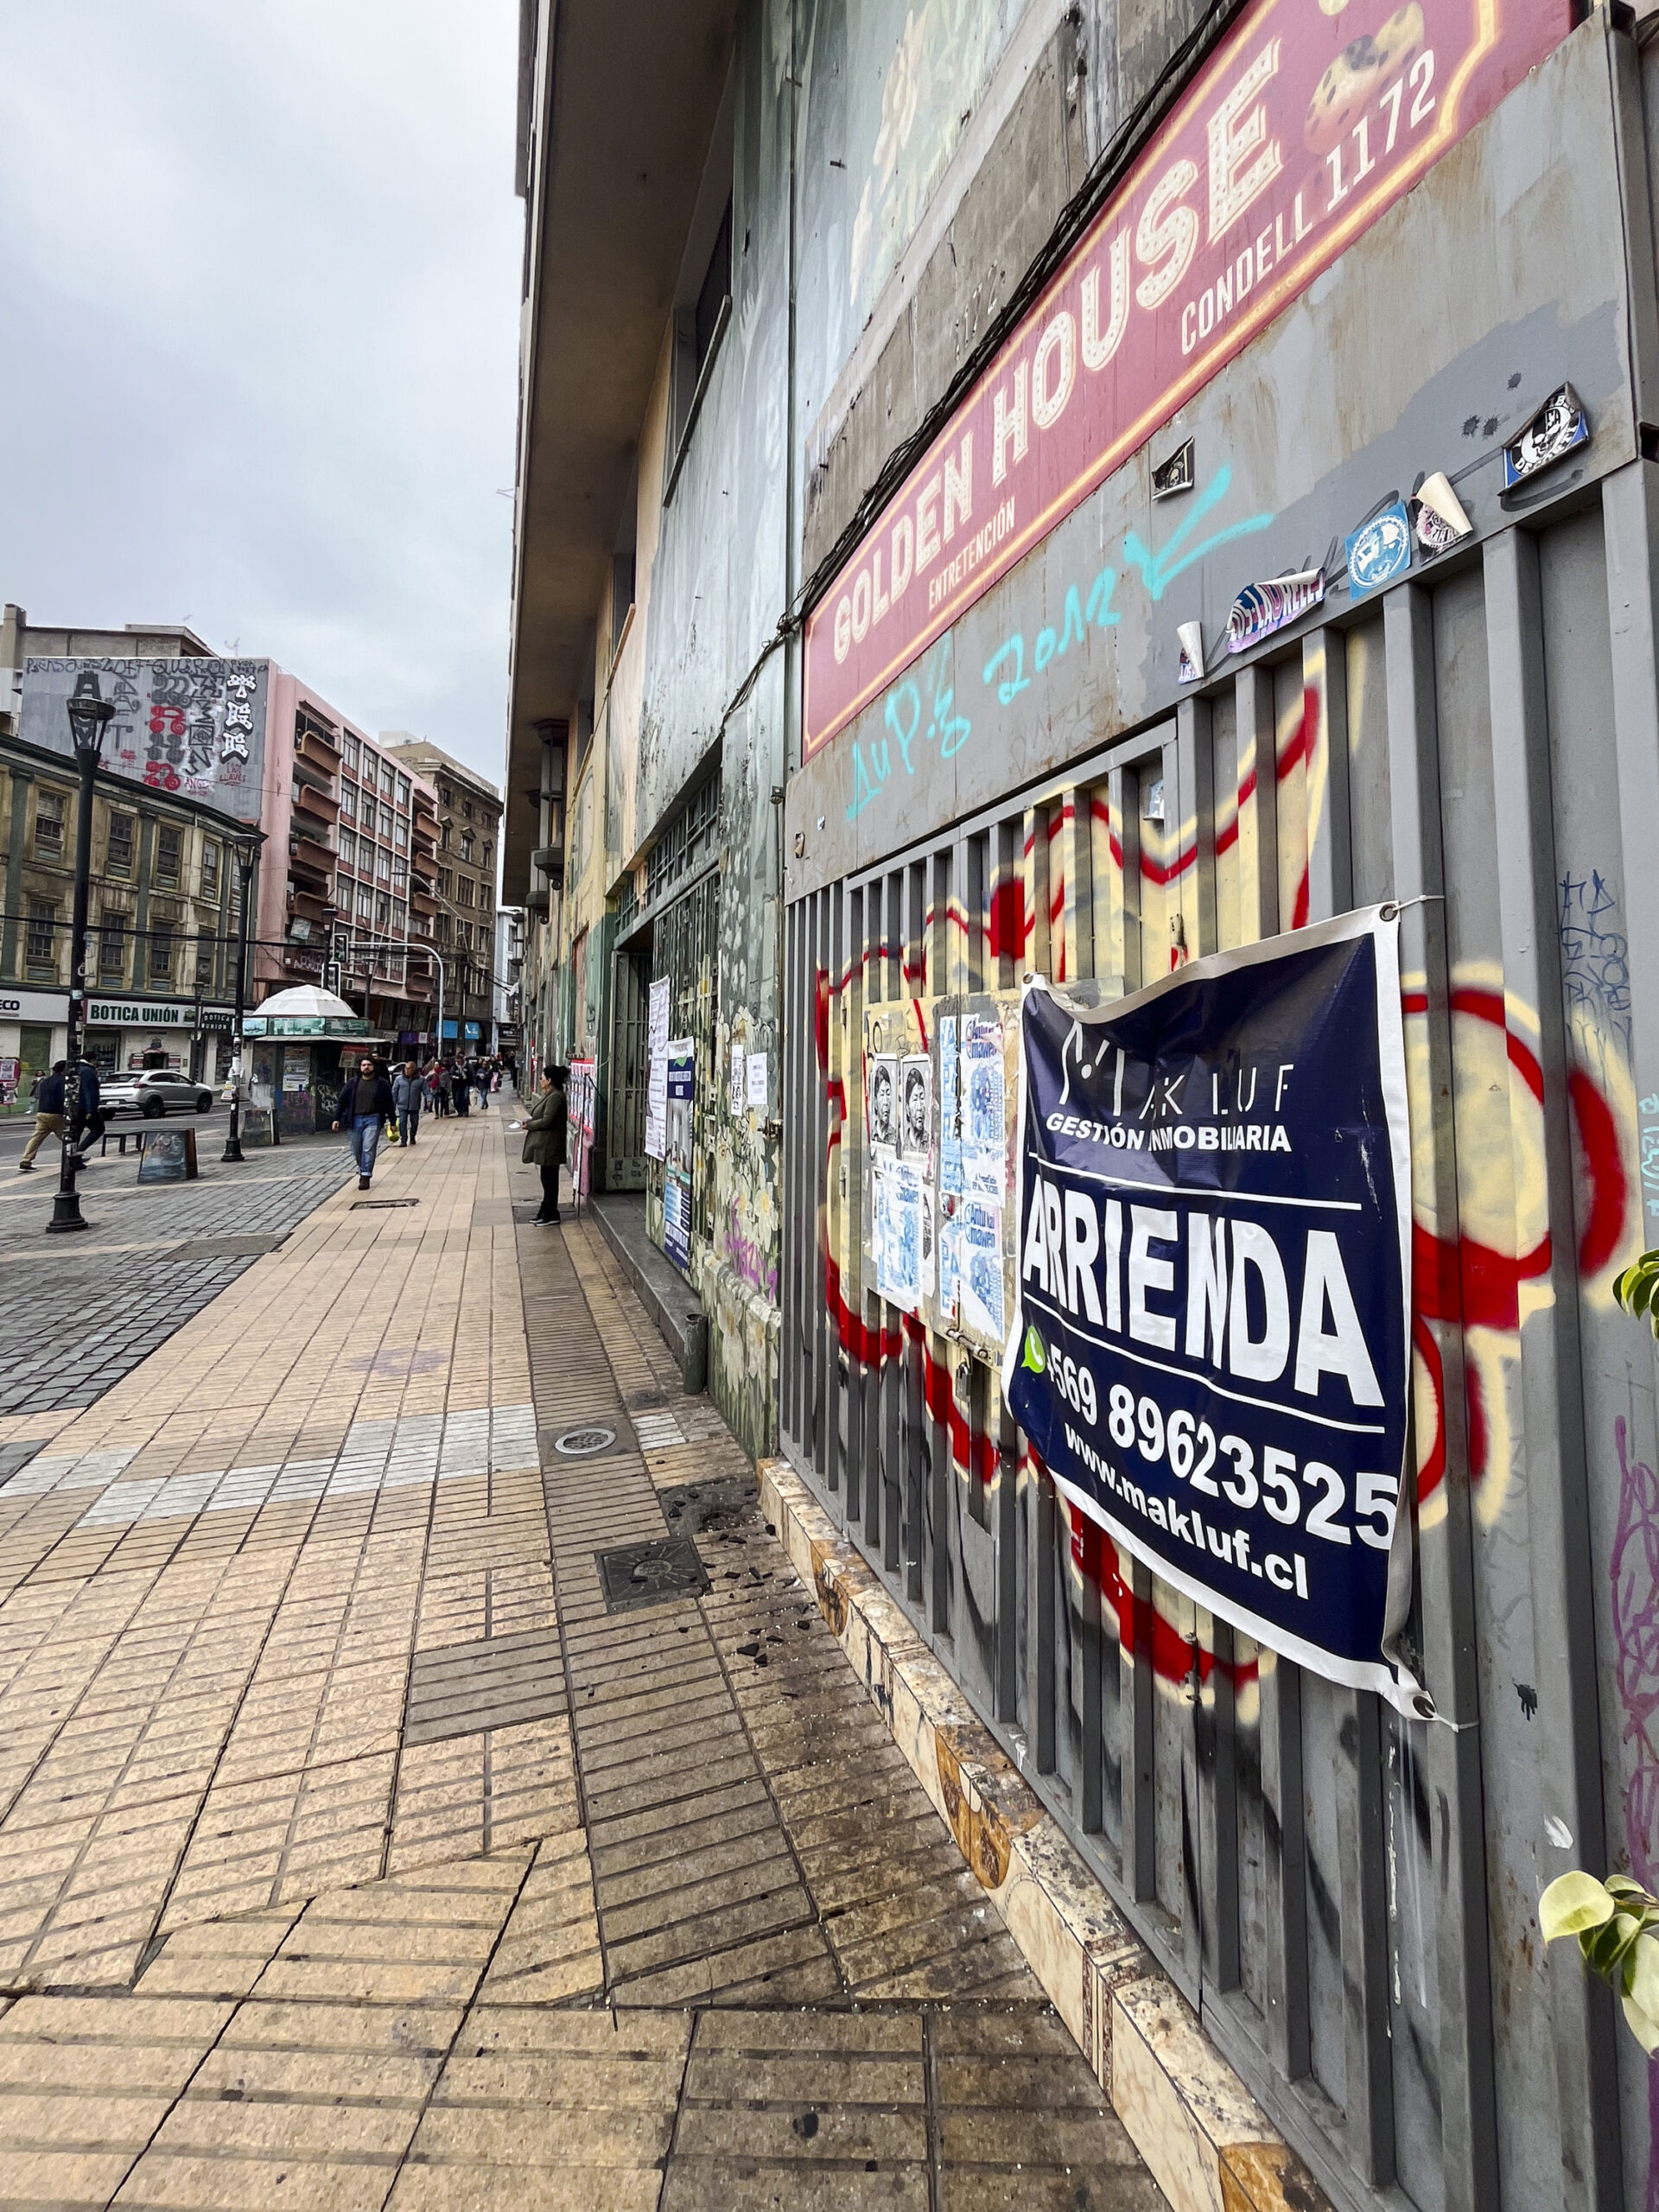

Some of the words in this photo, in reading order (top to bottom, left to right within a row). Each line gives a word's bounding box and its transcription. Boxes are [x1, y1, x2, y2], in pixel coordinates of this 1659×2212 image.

[1181, 192, 1313, 356] CONDELL
[1326, 49, 1436, 213] 1172
[834, 429, 973, 664] GOLDEN
[992, 36, 1284, 489] HOUSE
[928, 496, 1015, 613] ENTRETENCIÓN
[91, 1005, 140, 1021] BOTICA
[142, 1007, 179, 1023] UNIÓN
[1046, 1112, 1145, 1151] GESTIÓN
[1148, 1124, 1293, 1152] INMOBILIARIA
[1023, 1173, 1385, 1407] ARRIENDA
[1046, 1343, 1097, 1426] +569
[1109, 1384, 1399, 1551] 89623525
[1065, 1421, 1310, 1600] www.makluf.cl
